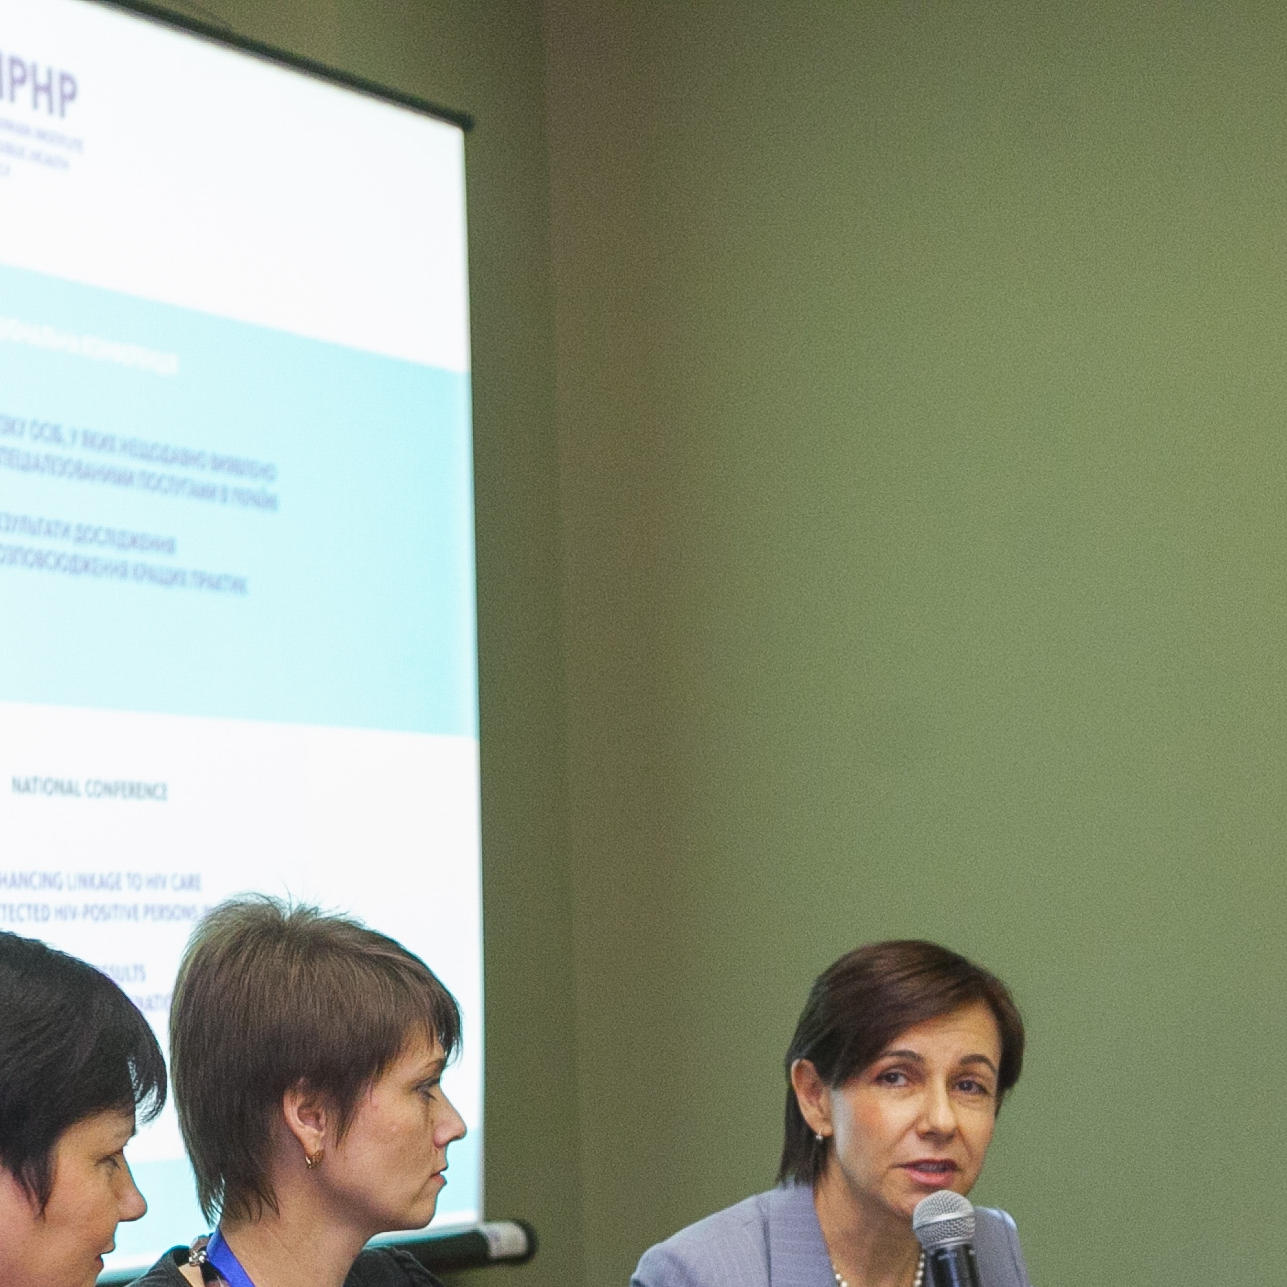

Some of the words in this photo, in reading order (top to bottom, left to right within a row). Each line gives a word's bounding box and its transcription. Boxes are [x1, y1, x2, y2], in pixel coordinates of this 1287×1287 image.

[11, 775, 82, 798] NATIONAL
[84, 778, 169, 803] CONFERENCE
[67, 871, 122, 892] LINKAGE
[126, 872, 142, 892] TO
[145, 872, 168, 892] HIV
[171, 872, 202, 893] CARE
[53, 903, 140, 922] HIV-POSITIVE
